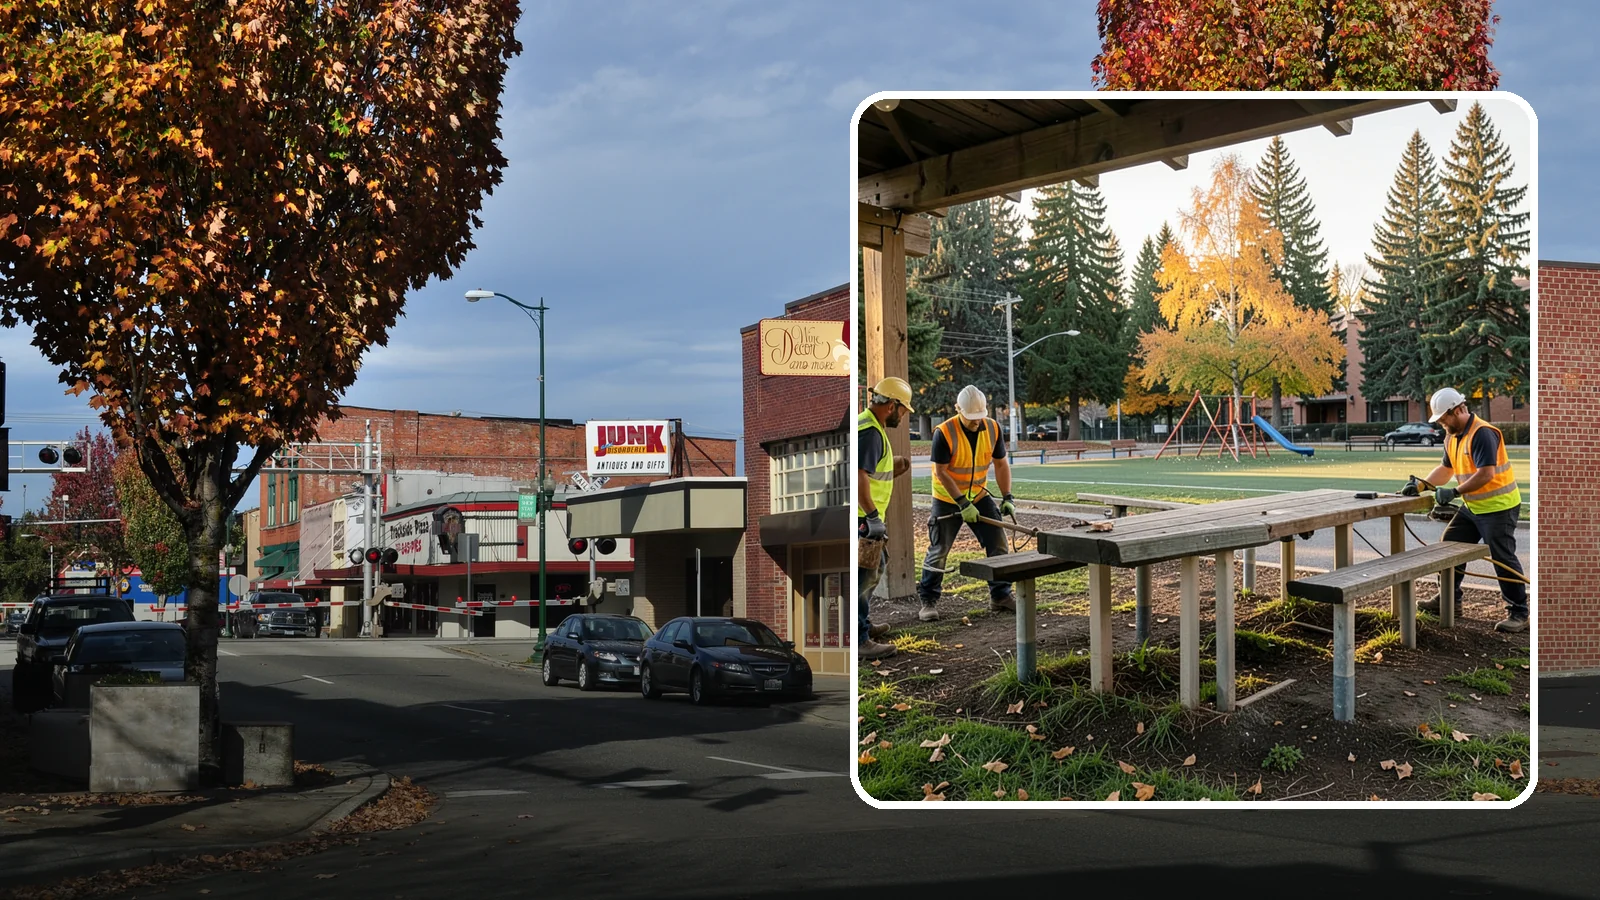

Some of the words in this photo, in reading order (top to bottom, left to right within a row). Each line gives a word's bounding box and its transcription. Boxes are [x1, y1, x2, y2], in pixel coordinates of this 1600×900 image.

[595, 425, 666, 457] JUNK
[597, 461, 628, 470] ANTIQUES
[631, 461, 643, 470] AND
[647, 460, 665, 470] GIFTS
[390, 521, 413, 540] Trackside
[414, 519, 429, 536] Pizza
